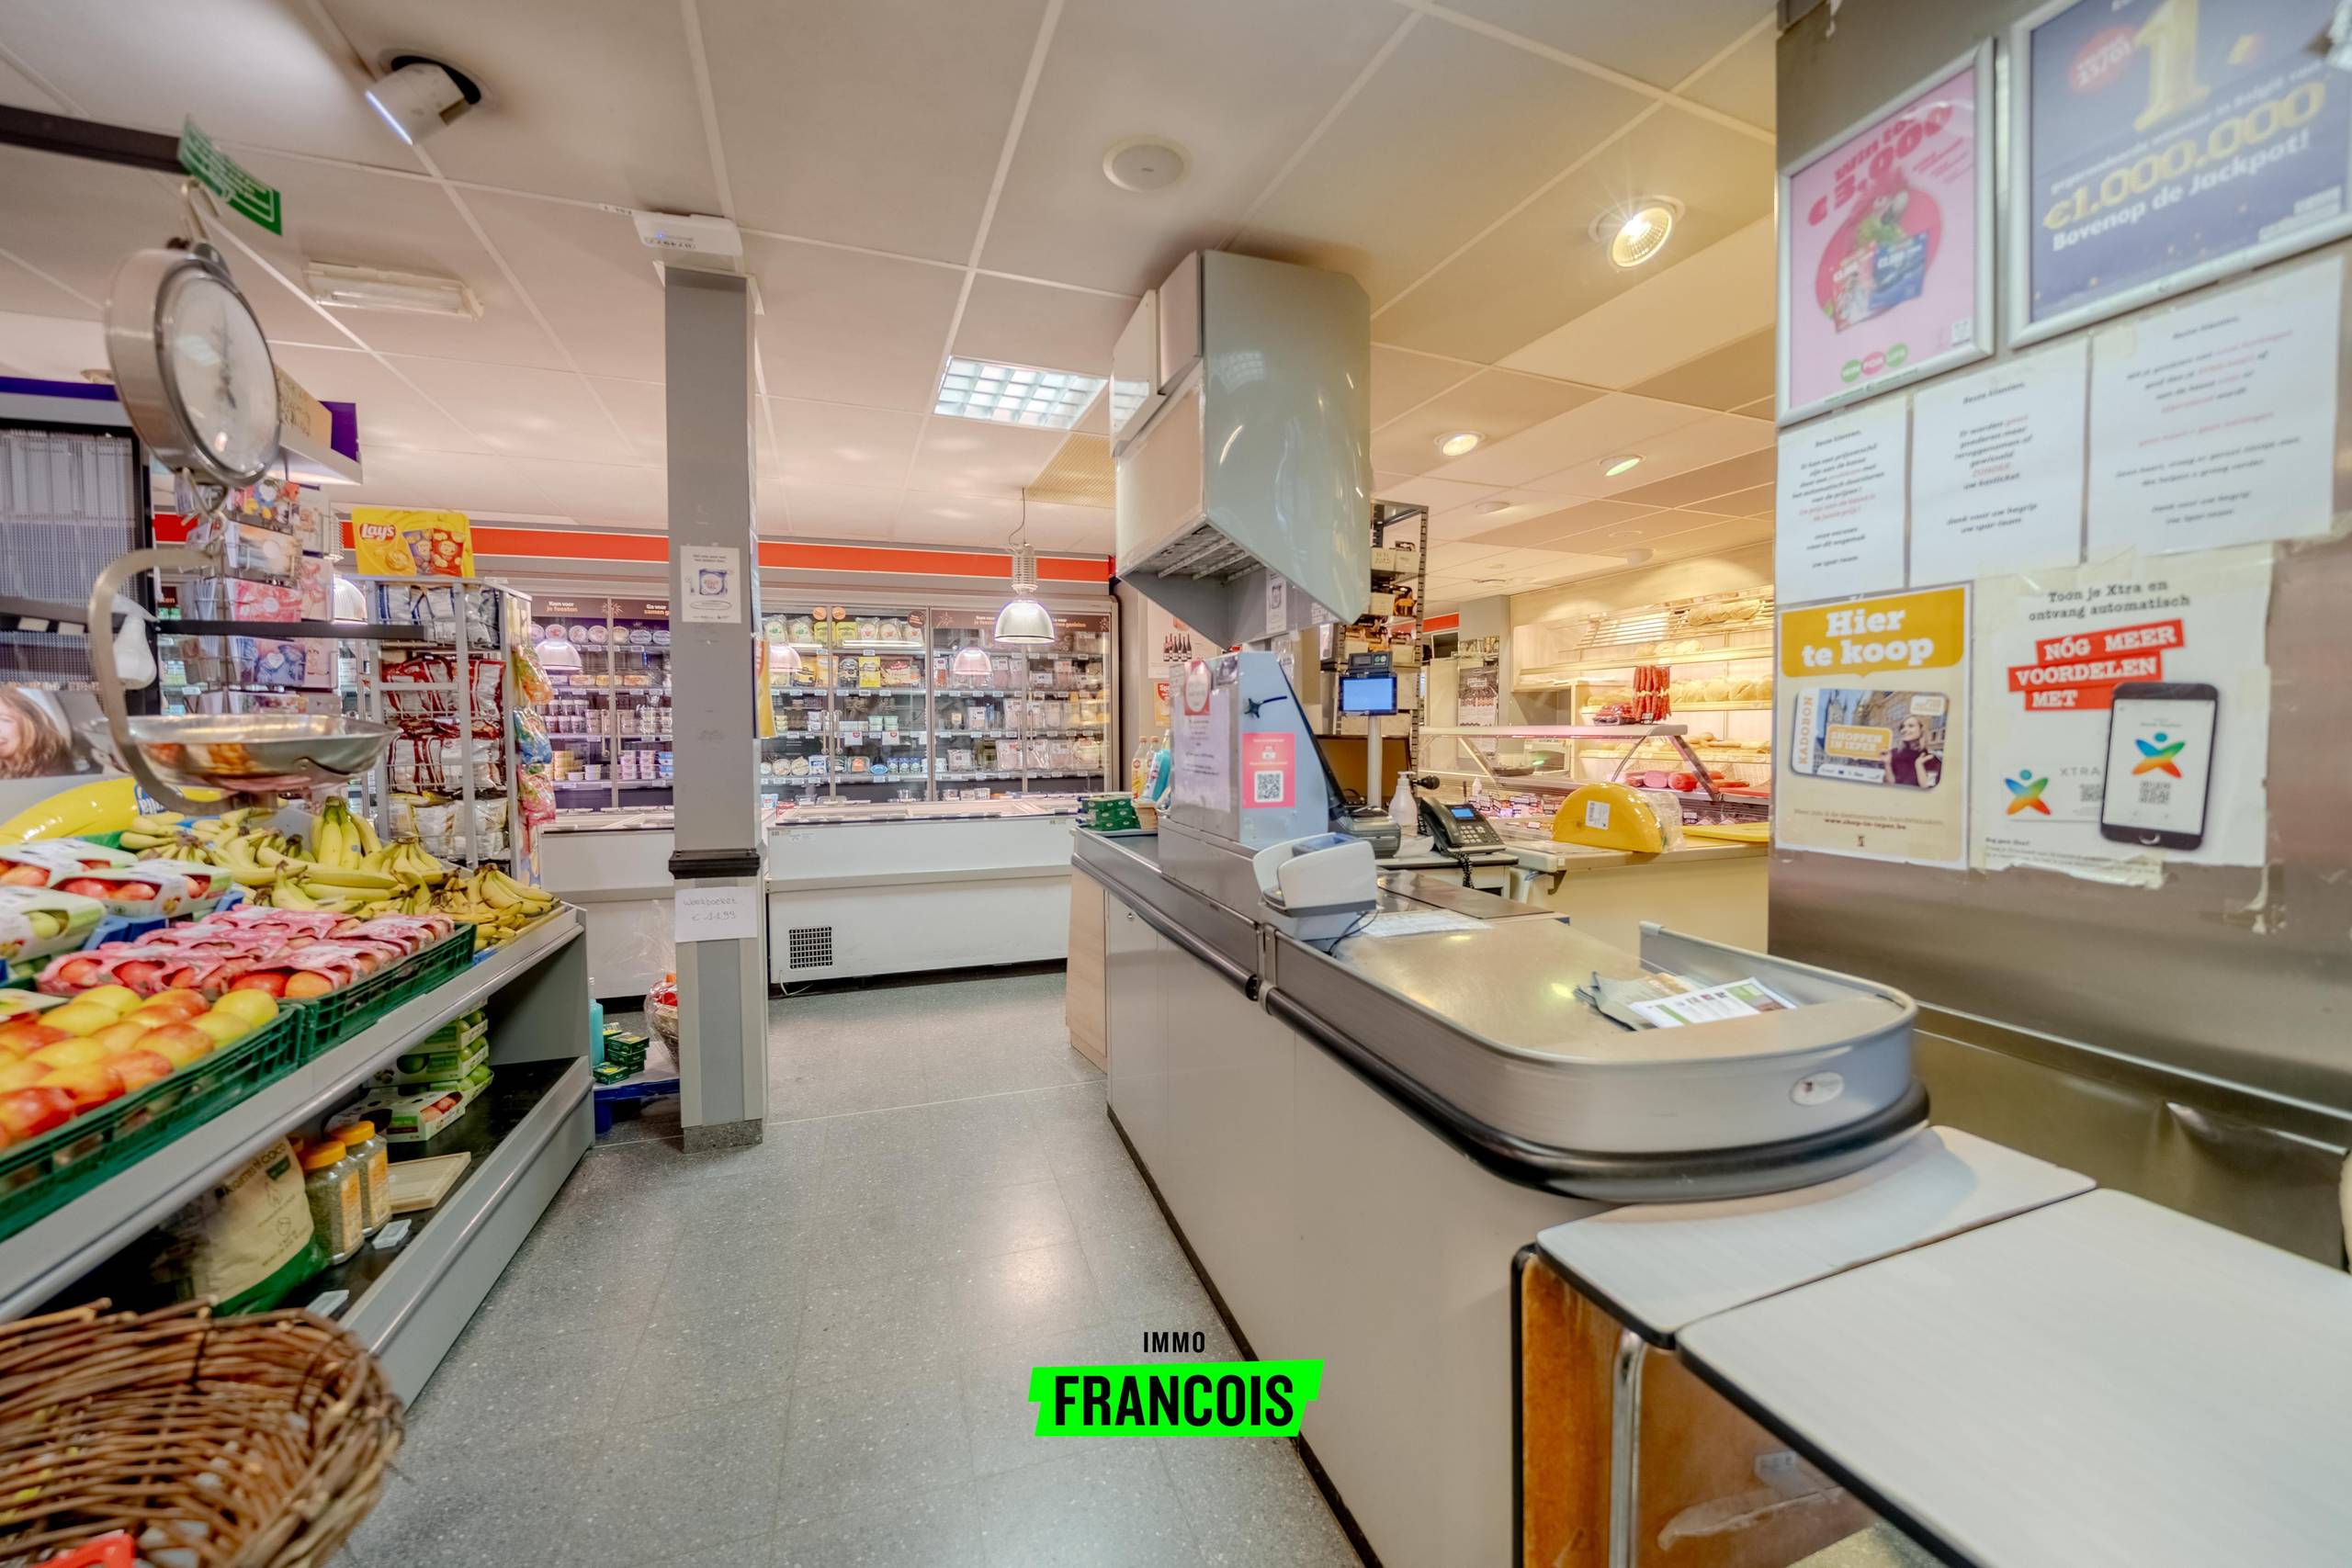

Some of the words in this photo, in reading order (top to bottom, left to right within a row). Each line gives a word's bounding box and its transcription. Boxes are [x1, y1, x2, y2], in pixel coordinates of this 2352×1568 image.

[2052, 201, 2147, 251] Bovenop
[2152, 185, 2184, 209] de
[2188, 128, 2309, 196] Jackpot!
[2048, 592, 2083, 603] Toon
[2087, 588, 2100, 601] je
[2107, 583, 2141, 597] Xtra
[2148, 581, 2167, 592] en
[1826, 608, 1906, 637] Hier
[2029, 606, 2086, 622] ontvang
[2090, 595, 2190, 615] automatisch
[1802, 645, 1833, 667] te
[1840, 637, 1934, 666] koop
[2043, 636, 2091, 661] NÓG
[2104, 626, 2177, 652] MEER
[2015, 657, 2157, 686] VOORDELEN
[2032, 689, 2078, 708] MET
[1799, 697, 1814, 764] KADOBON
[1829, 732, 1883, 741] SHOPPEN
[1830, 739, 1841, 750] IN
[2059, 767, 2100, 775] XTRA
